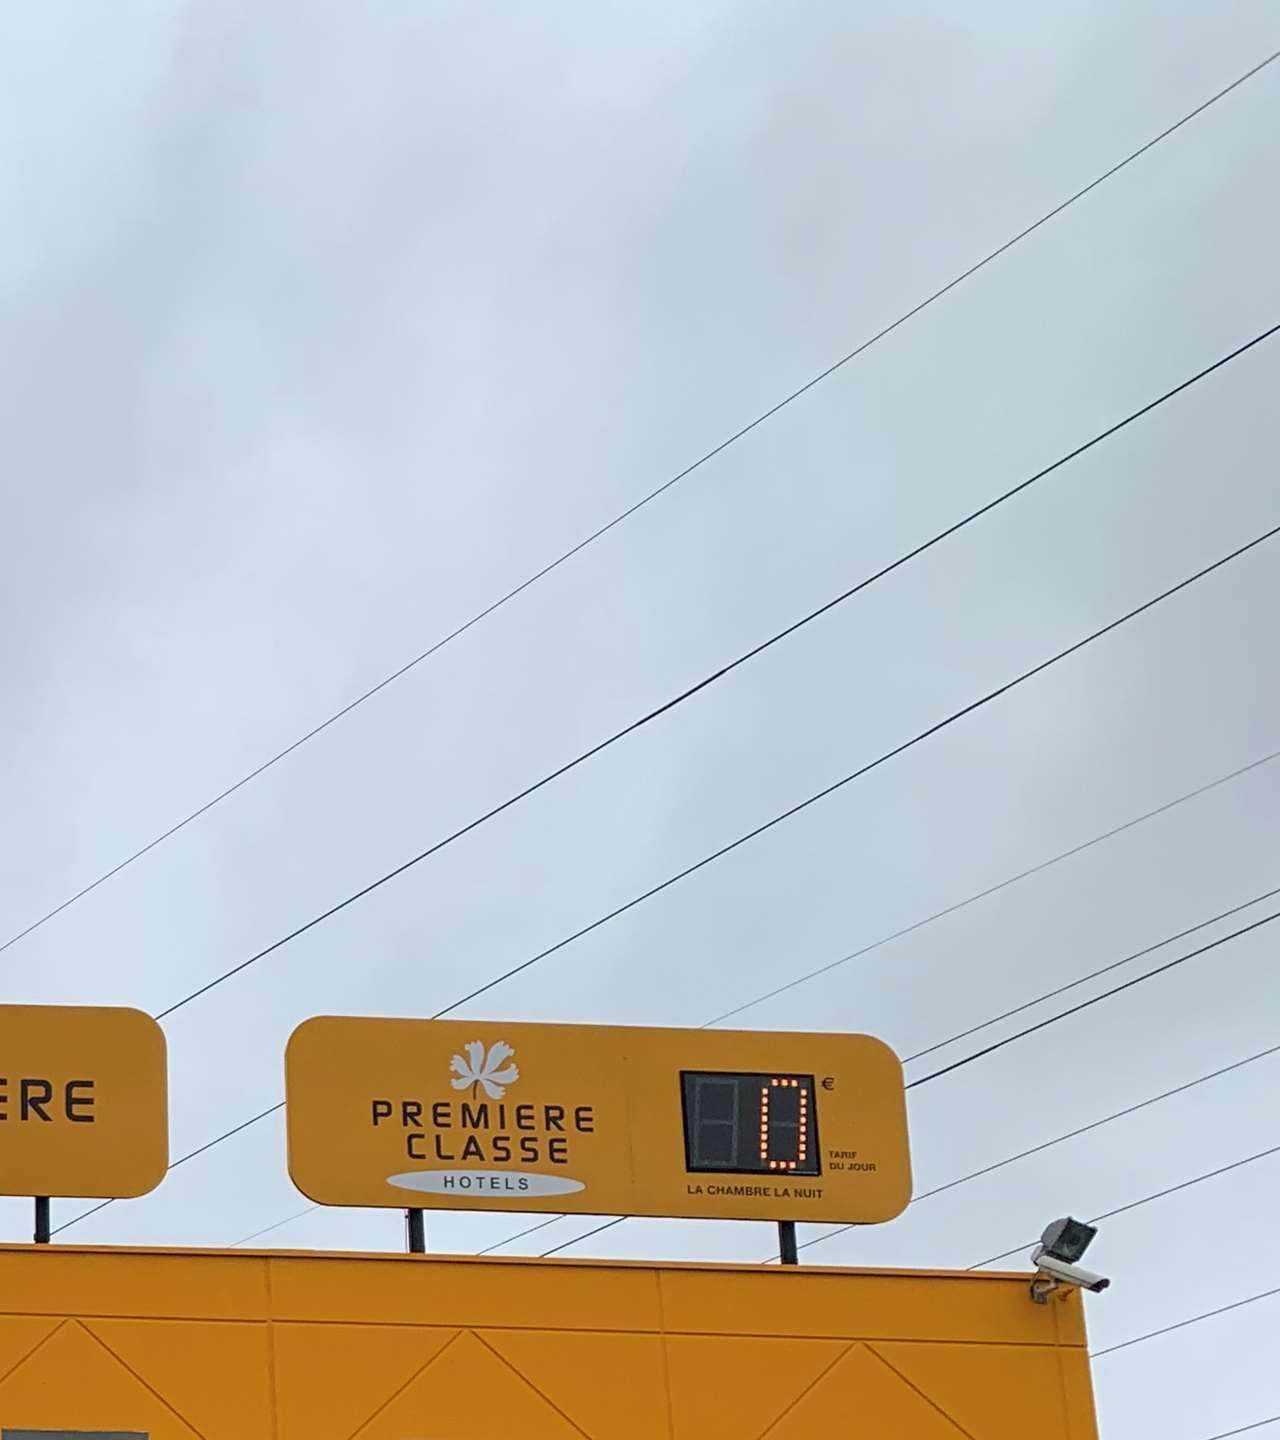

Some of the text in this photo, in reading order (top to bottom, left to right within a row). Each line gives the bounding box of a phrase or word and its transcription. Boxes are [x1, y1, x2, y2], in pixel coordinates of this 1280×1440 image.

[371, 1099, 596, 1133] PREMIERE
[406, 1132, 570, 1165] CLASSE
[829, 1150, 858, 1159] TARIF
[829, 1162, 877, 1172] DU JOUR
[443, 1175, 530, 1192] HOTELS
[687, 1185, 824, 1199] LA CHAMBRE LA NUIT
